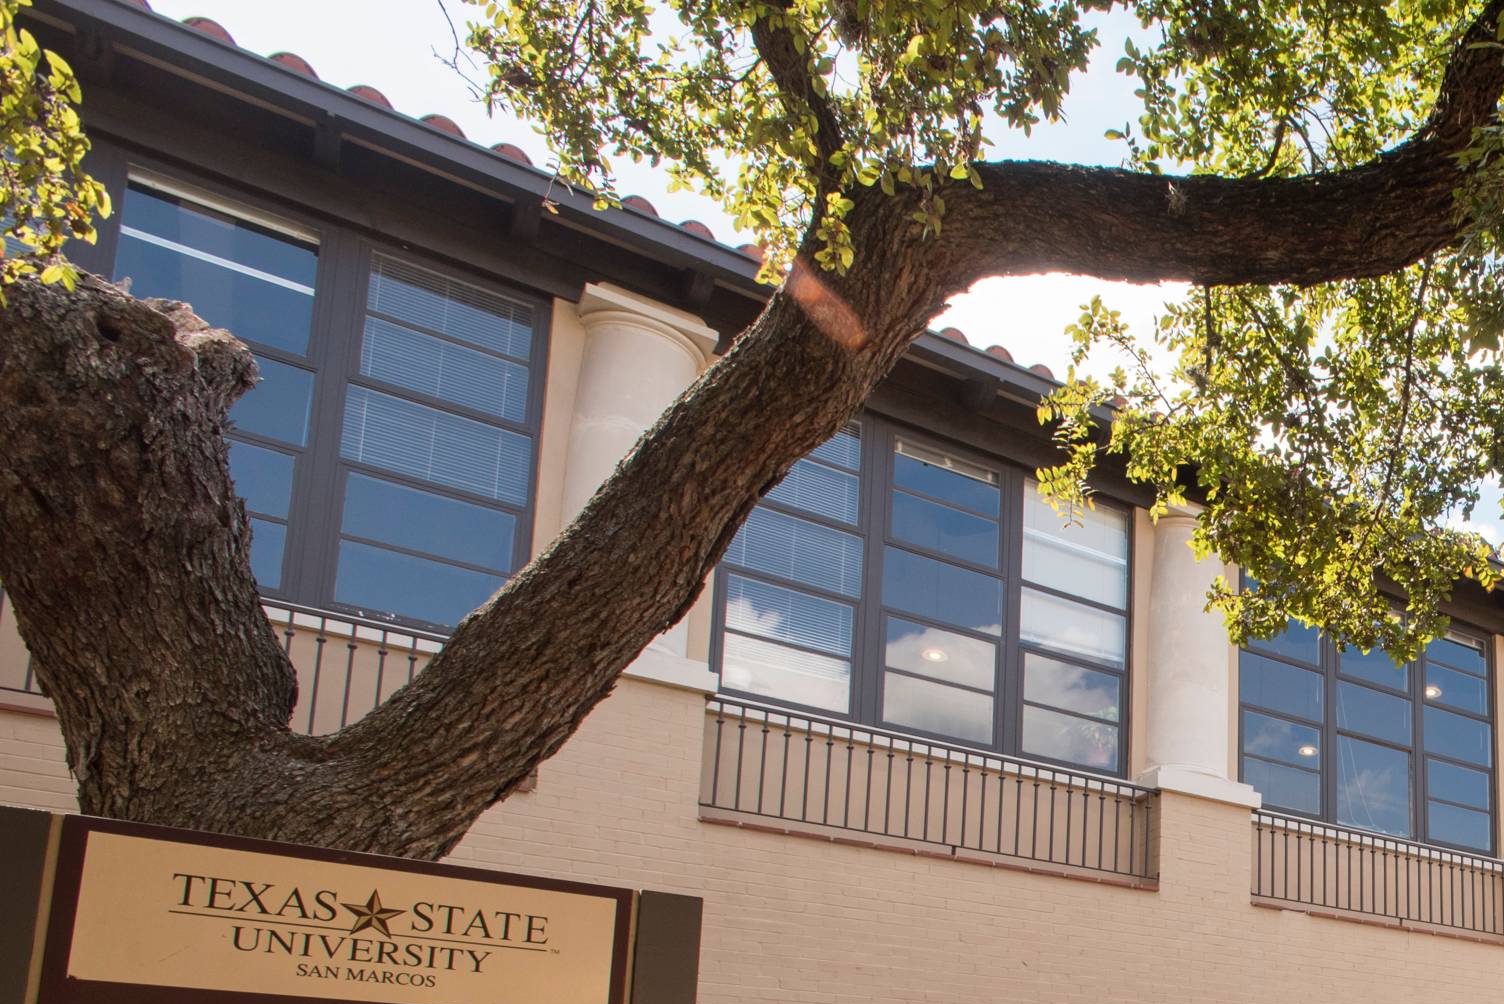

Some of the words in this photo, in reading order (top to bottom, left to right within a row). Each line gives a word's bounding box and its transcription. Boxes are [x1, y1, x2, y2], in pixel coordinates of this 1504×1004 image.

[172, 872, 338, 922] TEXAS
[411, 901, 549, 945] STATE
[232, 925, 492, 973] UNIVERSITY
[296, 963, 339, 980] SAN
[345, 968, 436, 988] MARCOS
